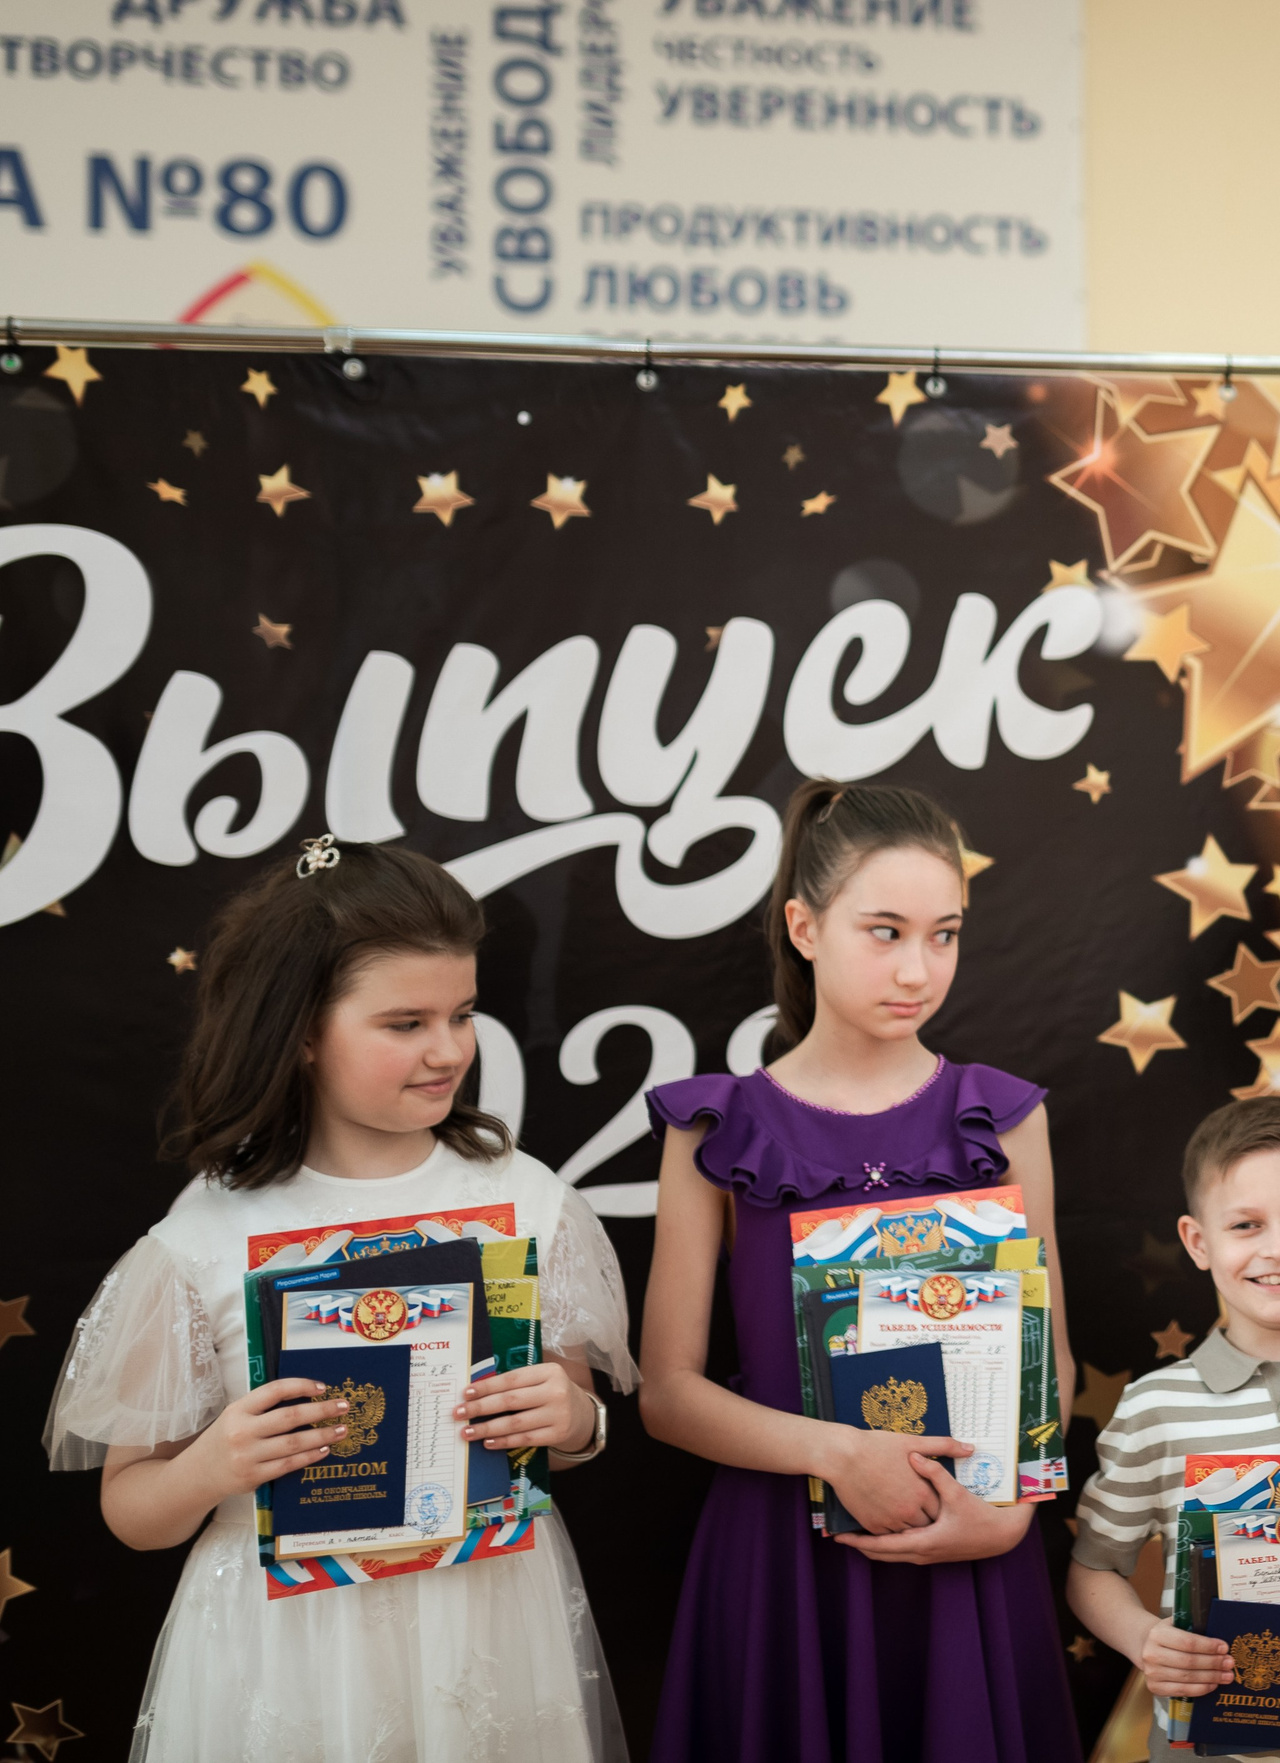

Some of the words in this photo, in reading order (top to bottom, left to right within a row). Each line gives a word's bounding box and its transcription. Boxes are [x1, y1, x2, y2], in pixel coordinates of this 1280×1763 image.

[0, 34, 352, 92] ТВОРЧЕСТВО
[653, 34, 882, 74] ЧЕСТНОСТЬ
[578, 0, 622, 166] ЛИДЕР
[655, 82, 1043, 138] УВЕРЕННОСТЬ
[579, 200, 1048, 257] ПРОДУКТИВНОСТЬ
[581, 265, 852, 317] ЛЮБОВЬ
[879, 1324, 918, 1332] ТАБЕЛЬ
[919, 1324, 1003, 1332] УСПЕВАЕМОСТИ
[301, 1461, 388, 1484] ДИПЛОМ
[324, 1484, 377, 1494] ОКОНЧАНИИ
[299, 1493, 351, 1505] НАЧАЛЬНОЙ
[352, 1491, 387, 1500] ШКОЛЫ
[1238, 1554, 1278, 1565] ТАБЕЛЬ
